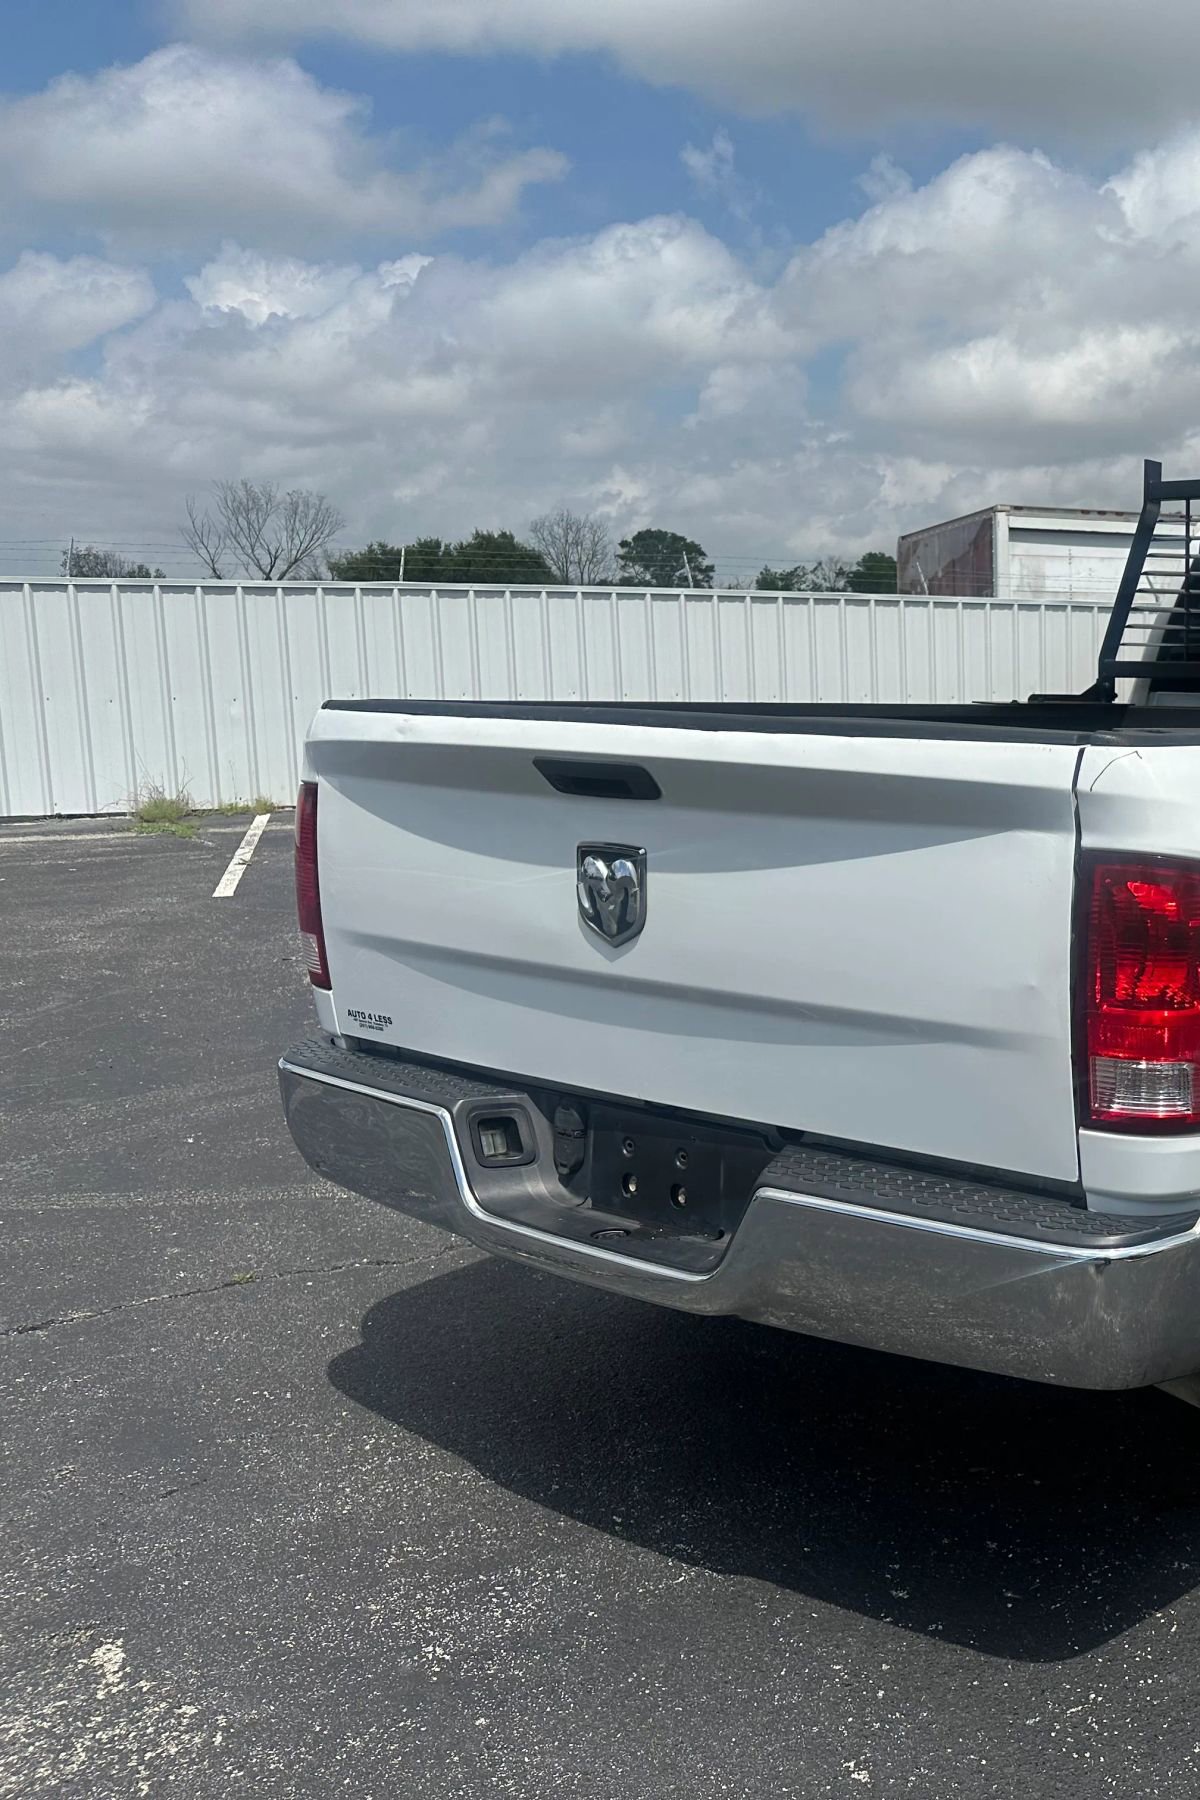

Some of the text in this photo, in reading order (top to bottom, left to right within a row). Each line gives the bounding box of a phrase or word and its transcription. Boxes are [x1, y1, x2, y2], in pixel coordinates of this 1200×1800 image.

[347, 1009, 366, 1020] AUTO
[367, 1013, 373, 1021] 4
[373, 1014, 393, 1025] LESS
